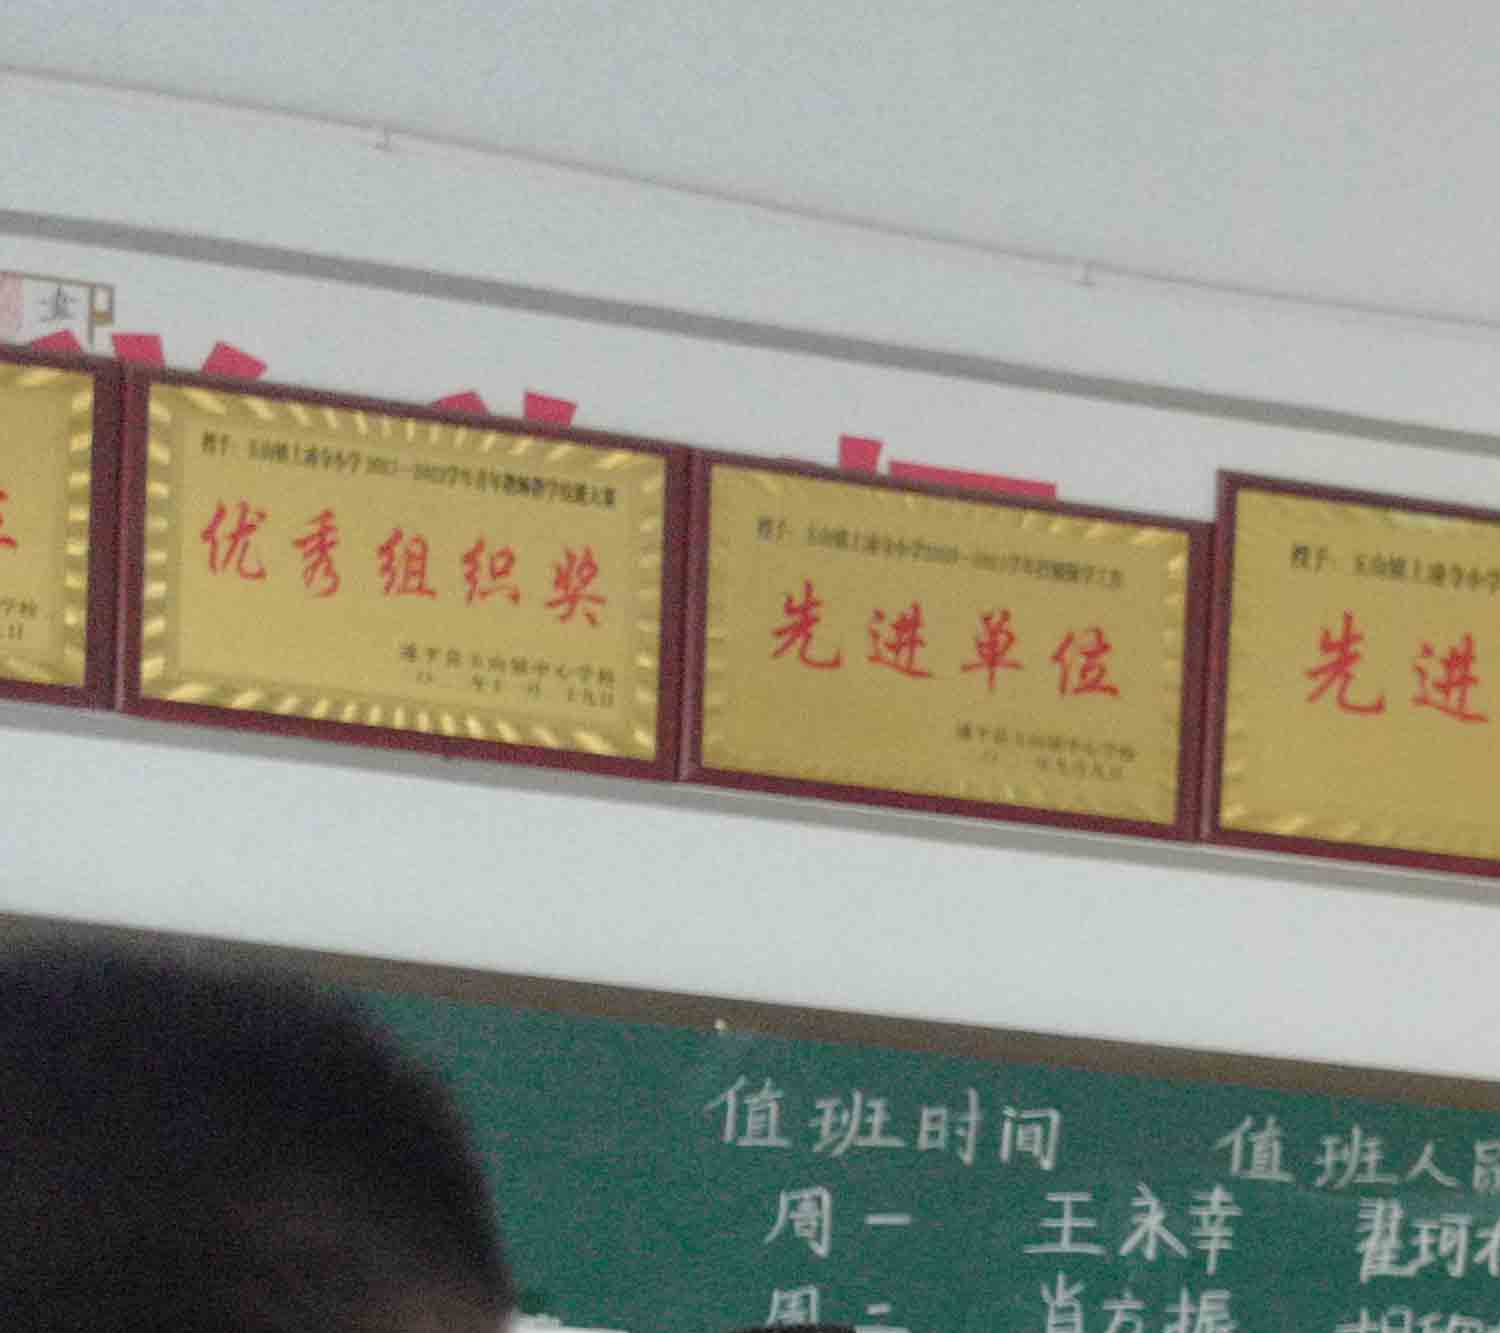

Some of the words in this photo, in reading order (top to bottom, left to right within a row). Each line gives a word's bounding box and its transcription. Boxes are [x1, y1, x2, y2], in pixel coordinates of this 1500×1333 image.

[200, 496, 607, 628] 优秀组织奖
[772, 578, 1120, 697] 先进单位
[704, 1075, 1062, 1171] 值班时间
[764, 1185, 912, 1257] 周一
